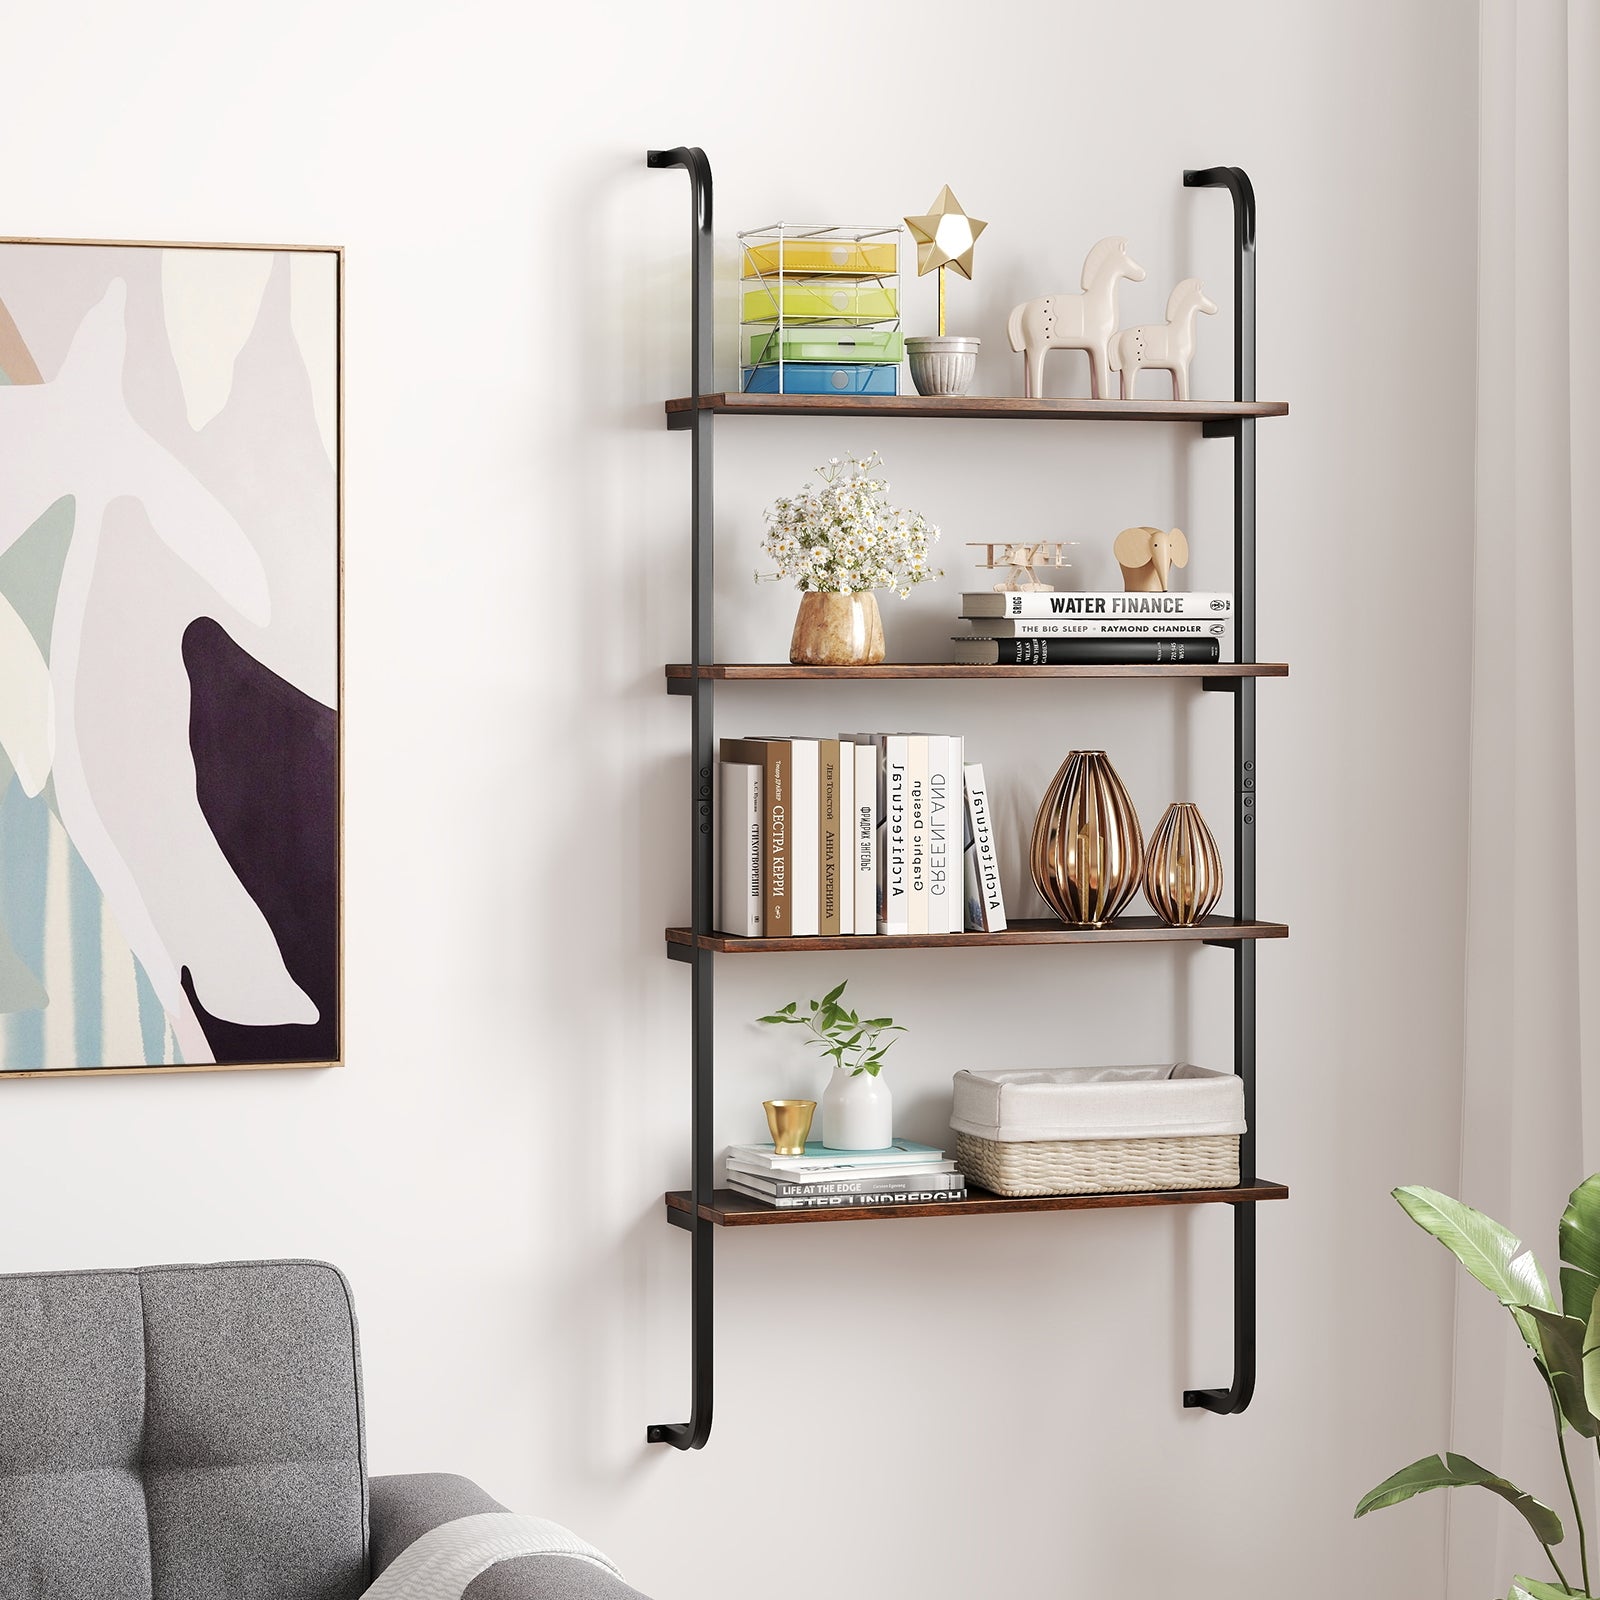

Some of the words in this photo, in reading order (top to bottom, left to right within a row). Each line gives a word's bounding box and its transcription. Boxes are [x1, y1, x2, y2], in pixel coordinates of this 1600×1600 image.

[1049, 597, 1106, 614] WATER
[1111, 597, 1184, 614] FINANCE
[1021, 625, 1039, 633] THE
[1042, 625, 1059, 633] BIG
[1062, 625, 1089, 633] SLEEP
[1100, 625, 1149, 633] RAYMOND
[1152, 625, 1202, 633] CHANDLER
[772, 805, 785, 854] СЕСТРА
[860, 806, 872, 840] ФРИДРИХ
[751, 823, 760, 897] СТИХОТВОРЕНИЯ
[860, 841, 872, 872] ЭНГЕЛЬС
[772, 856, 785, 897] КЕРРИ
[782, 1185, 802, 1195] LIFE
[803, 1185, 816, 1194] AT
[816, 1184, 835, 1193] THE
[836, 1183, 862, 1192] EDGE
